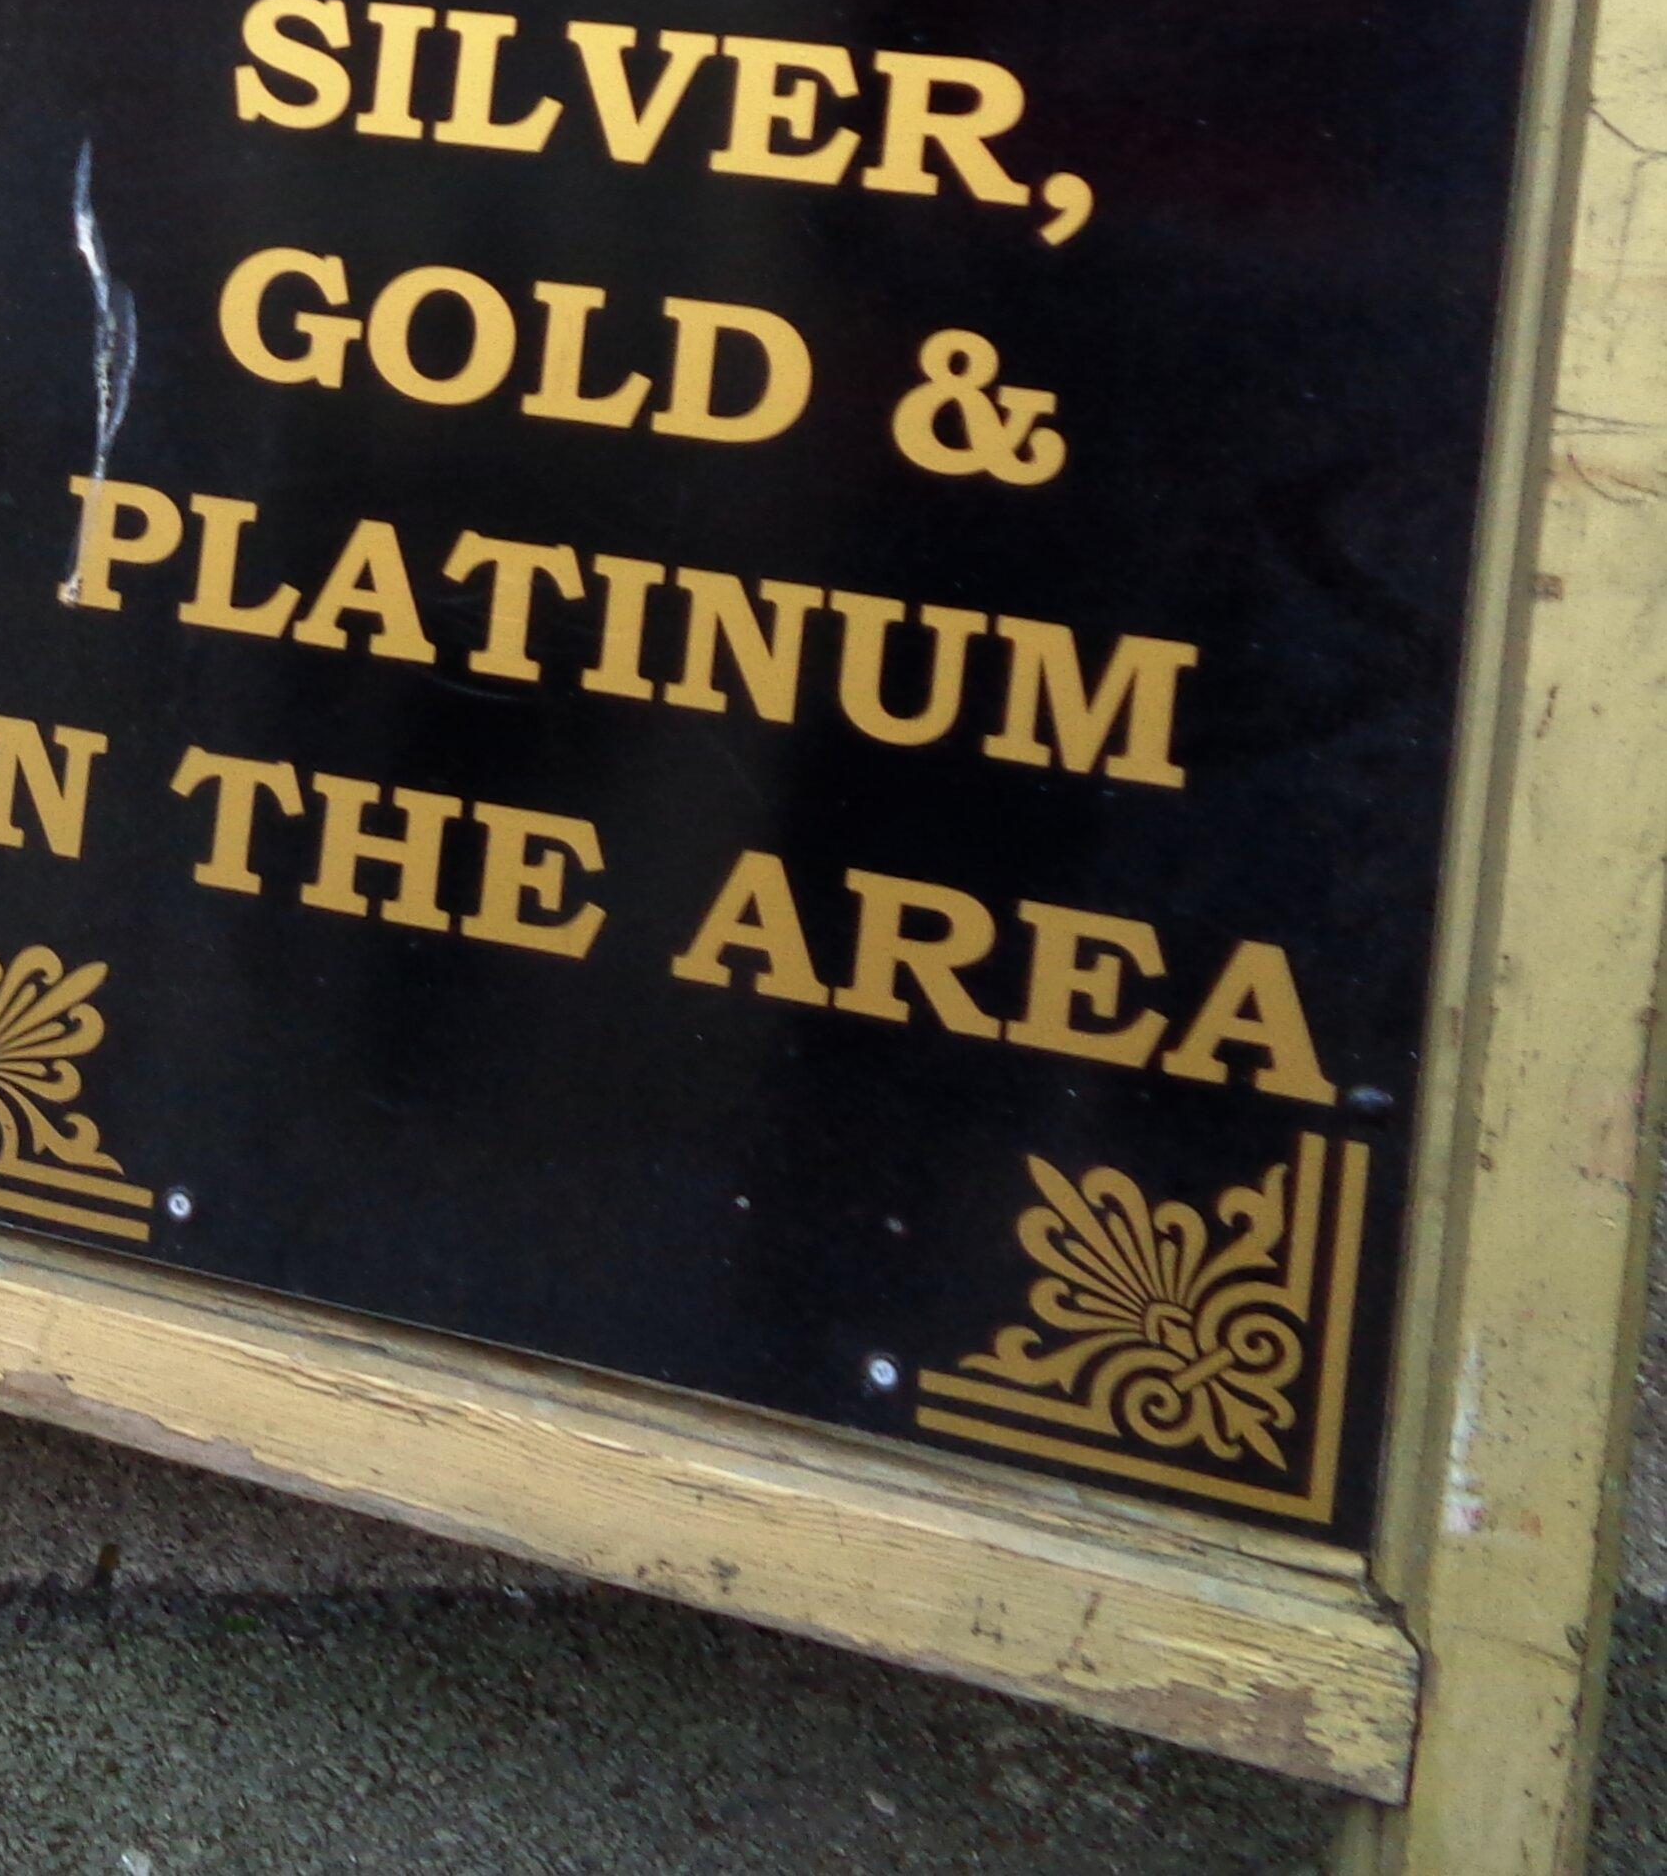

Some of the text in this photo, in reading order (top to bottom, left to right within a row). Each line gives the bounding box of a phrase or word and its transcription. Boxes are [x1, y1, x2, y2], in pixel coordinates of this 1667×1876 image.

[218, 246, 1067, 486] GOLD &
[59, 474, 1198, 789] PLATINUM
[170, 745, 606, 959] THE
[672, 850, 1338, 1105] AREA
